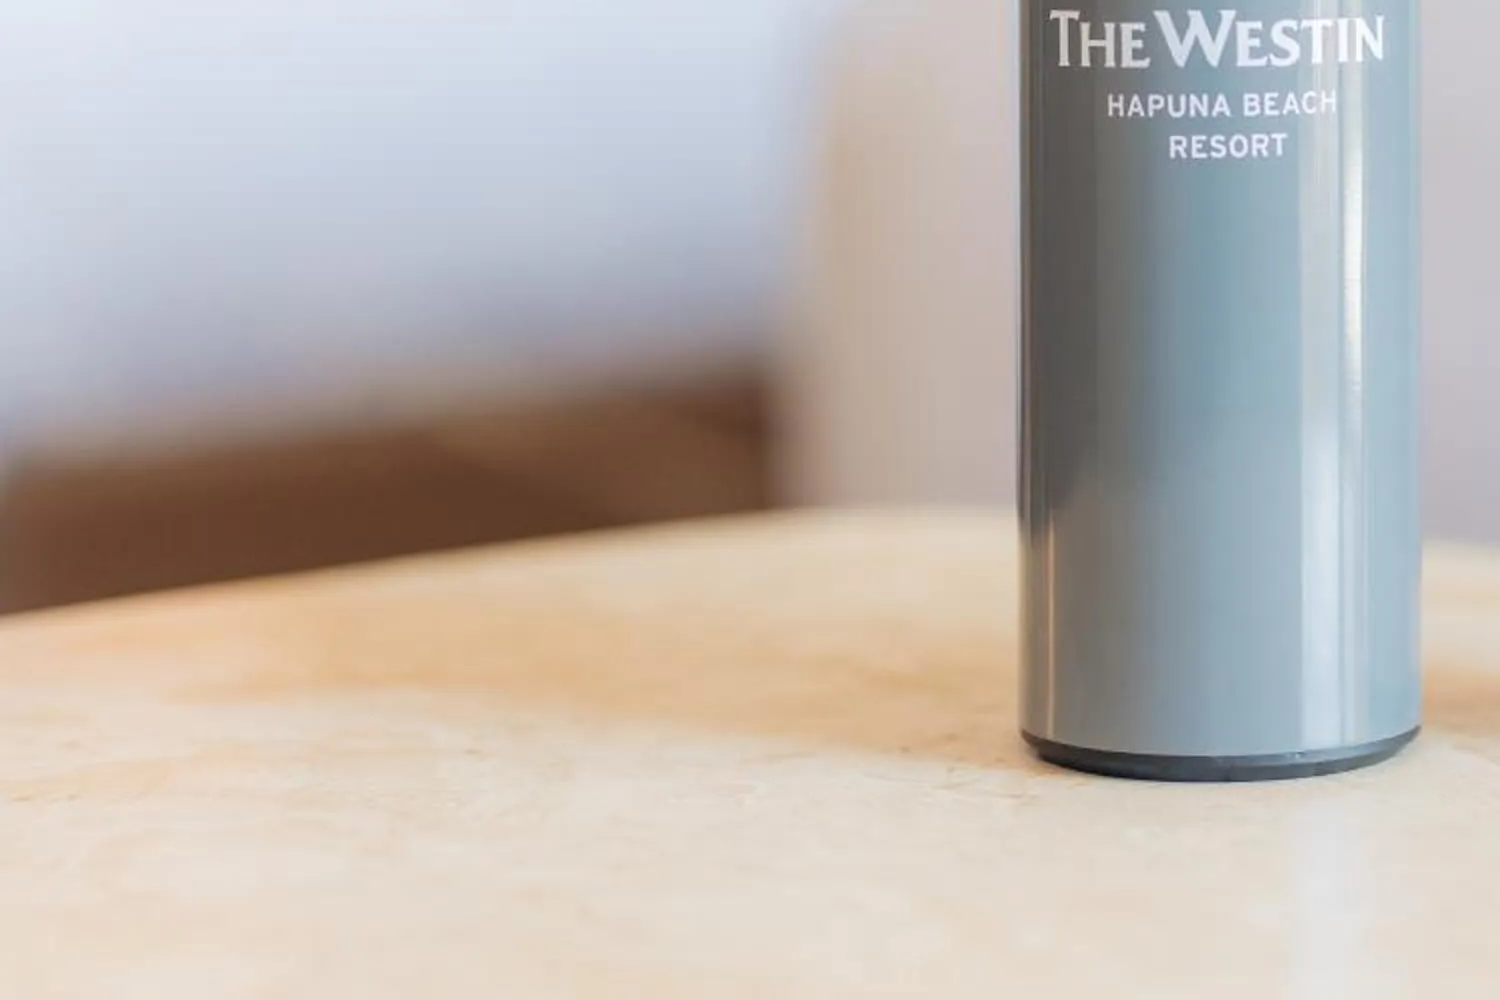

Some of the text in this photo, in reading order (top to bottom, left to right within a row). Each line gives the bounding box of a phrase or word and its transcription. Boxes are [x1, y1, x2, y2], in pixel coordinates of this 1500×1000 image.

[1049, 10, 1385, 68] THE WESTIN
[1107, 90, 1337, 118] HAPUNA BEACH
[1169, 133, 1288, 159] RESORT
